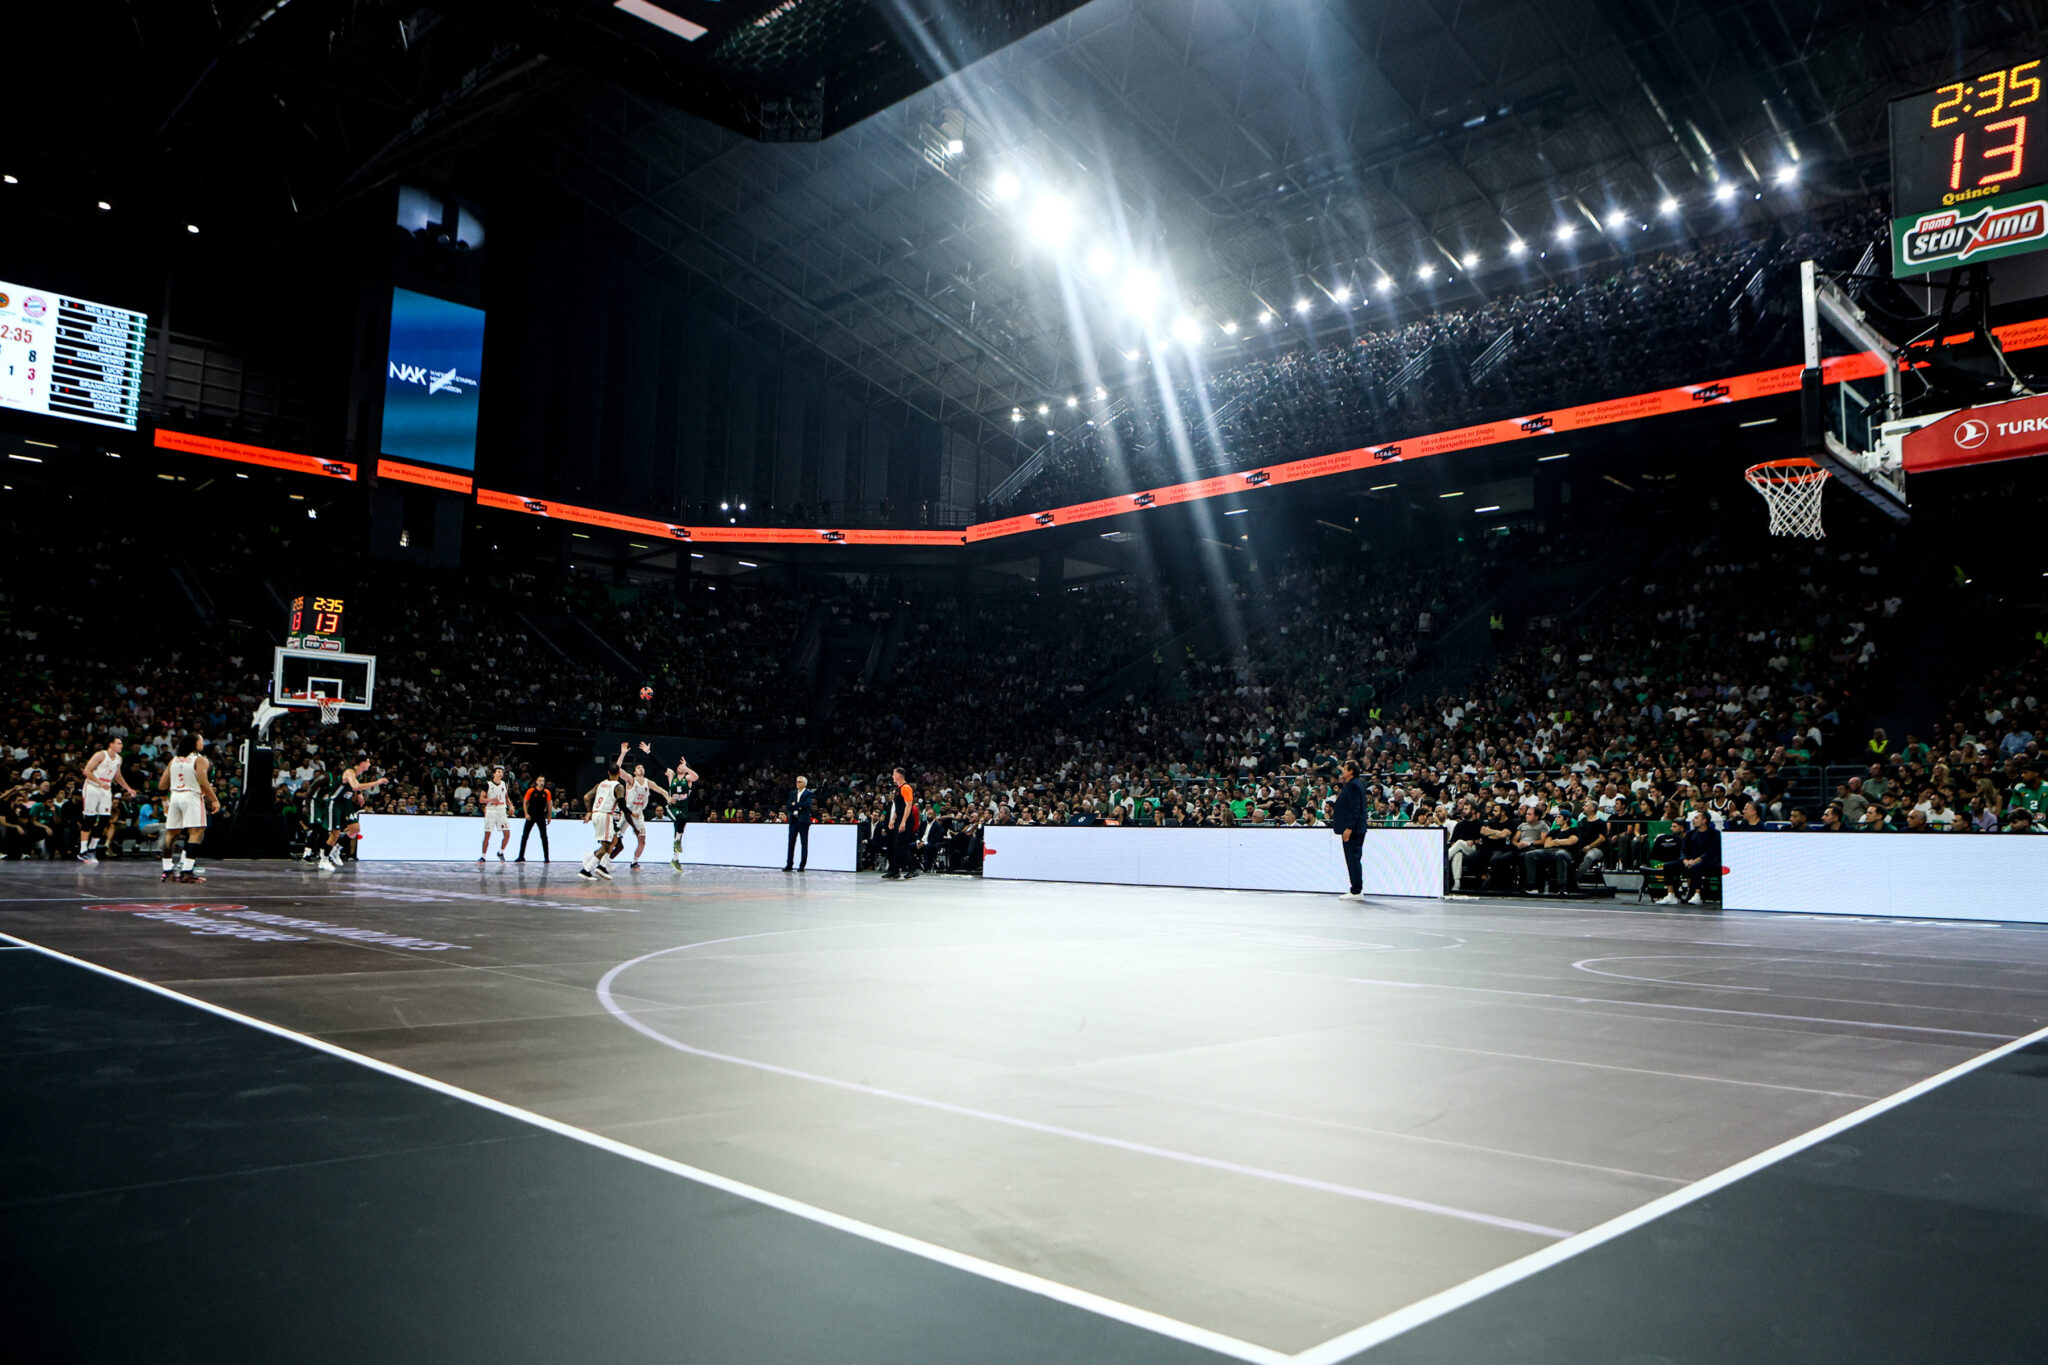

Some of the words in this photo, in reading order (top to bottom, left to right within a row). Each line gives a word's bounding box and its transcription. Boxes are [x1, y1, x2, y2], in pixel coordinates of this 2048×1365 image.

[1931, 59, 2041, 128] 2:35
[1950, 115, 2028, 190] 13
[1942, 184, 2001, 206] Quince
[28, 350, 37, 363] 8
[9, 365, 14, 376] 1
[27, 367, 36, 381] 3
[313, 597, 344, 614] 2:35
[316, 613, 339, 633] 13
[2030, 800, 2038, 810] 2
